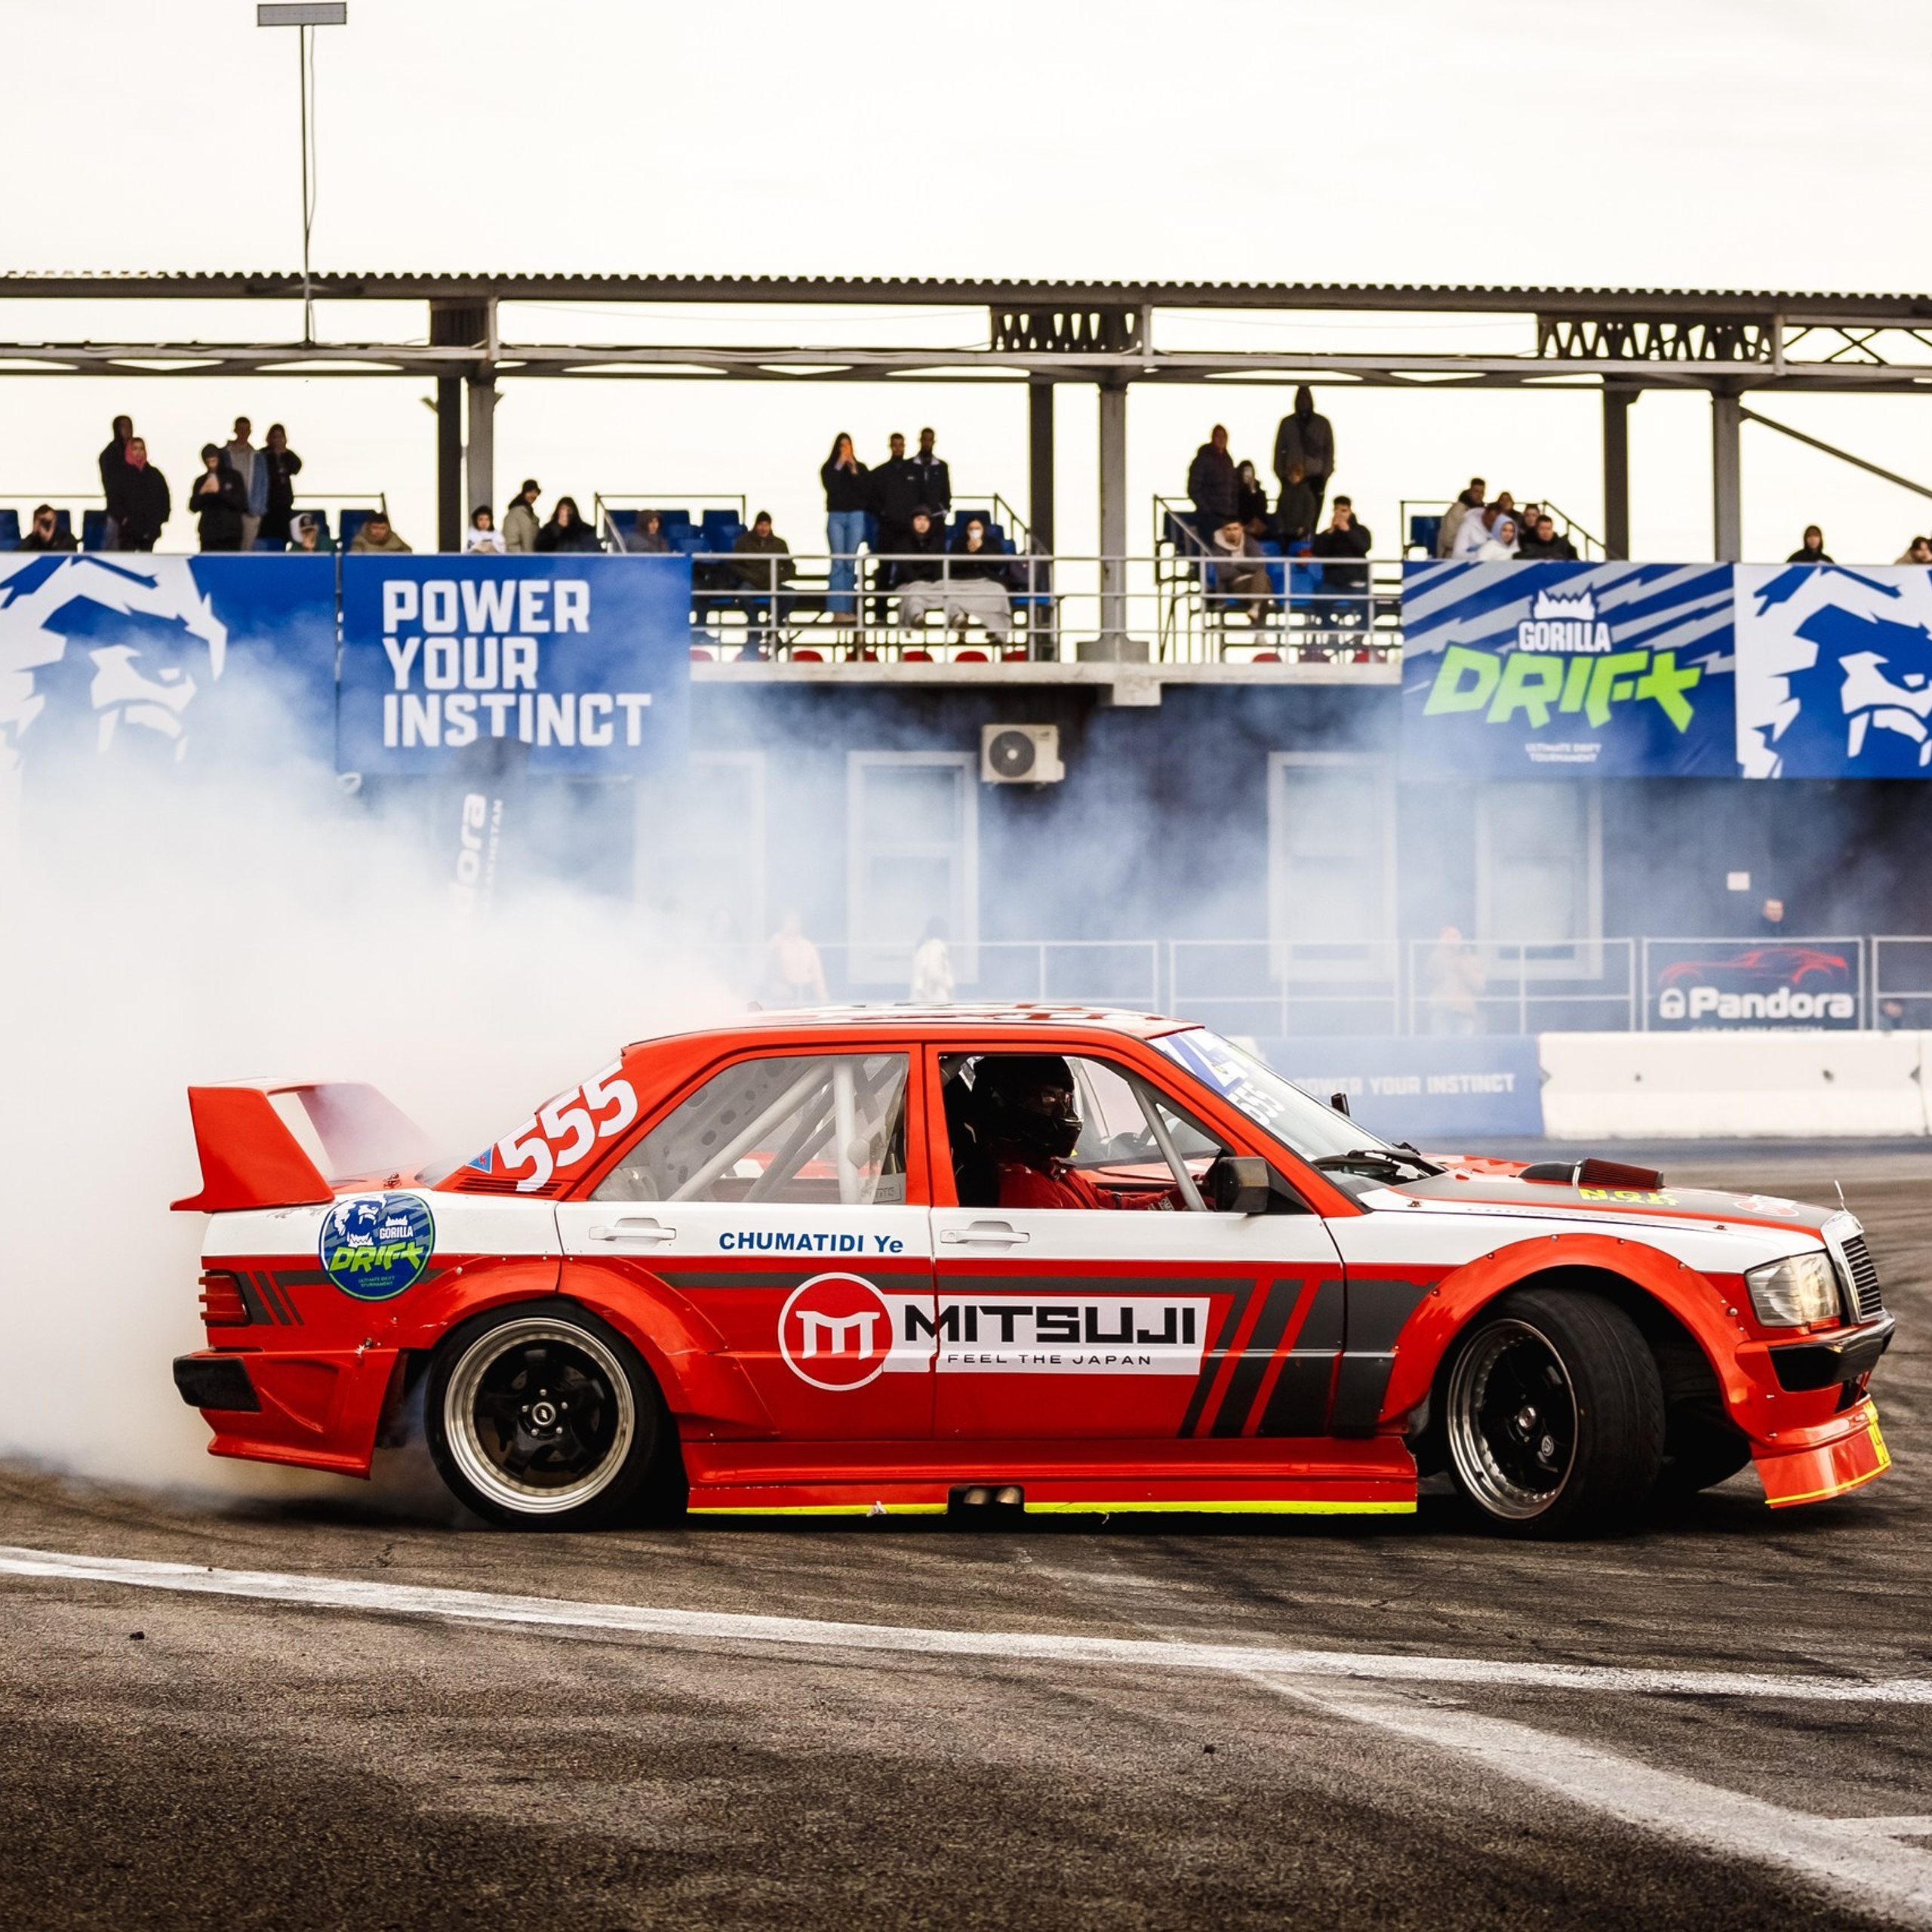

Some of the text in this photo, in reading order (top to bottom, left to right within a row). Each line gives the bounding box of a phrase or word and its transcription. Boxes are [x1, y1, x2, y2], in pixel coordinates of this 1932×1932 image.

[383, 580, 590, 633] POWER
[1518, 622, 1612, 652] GORILLA
[382, 636, 539, 690] YOUR
[383, 693, 652, 747] INSTINCT
[1689, 986, 1854, 1019] Pandora
[1369, 1076, 1421, 1094] YOUR
[1426, 1073, 1515, 1094] INSTINCT
[497, 1059, 638, 1192] 555
[380, 1226, 414, 1239] GORILLA
[718, 1232, 904, 1253] CHUMATIDI Ye
[905, 1305, 1195, 1344] MITSUJI
[948, 1355, 1152, 1365] FEEL THE JAPAN
